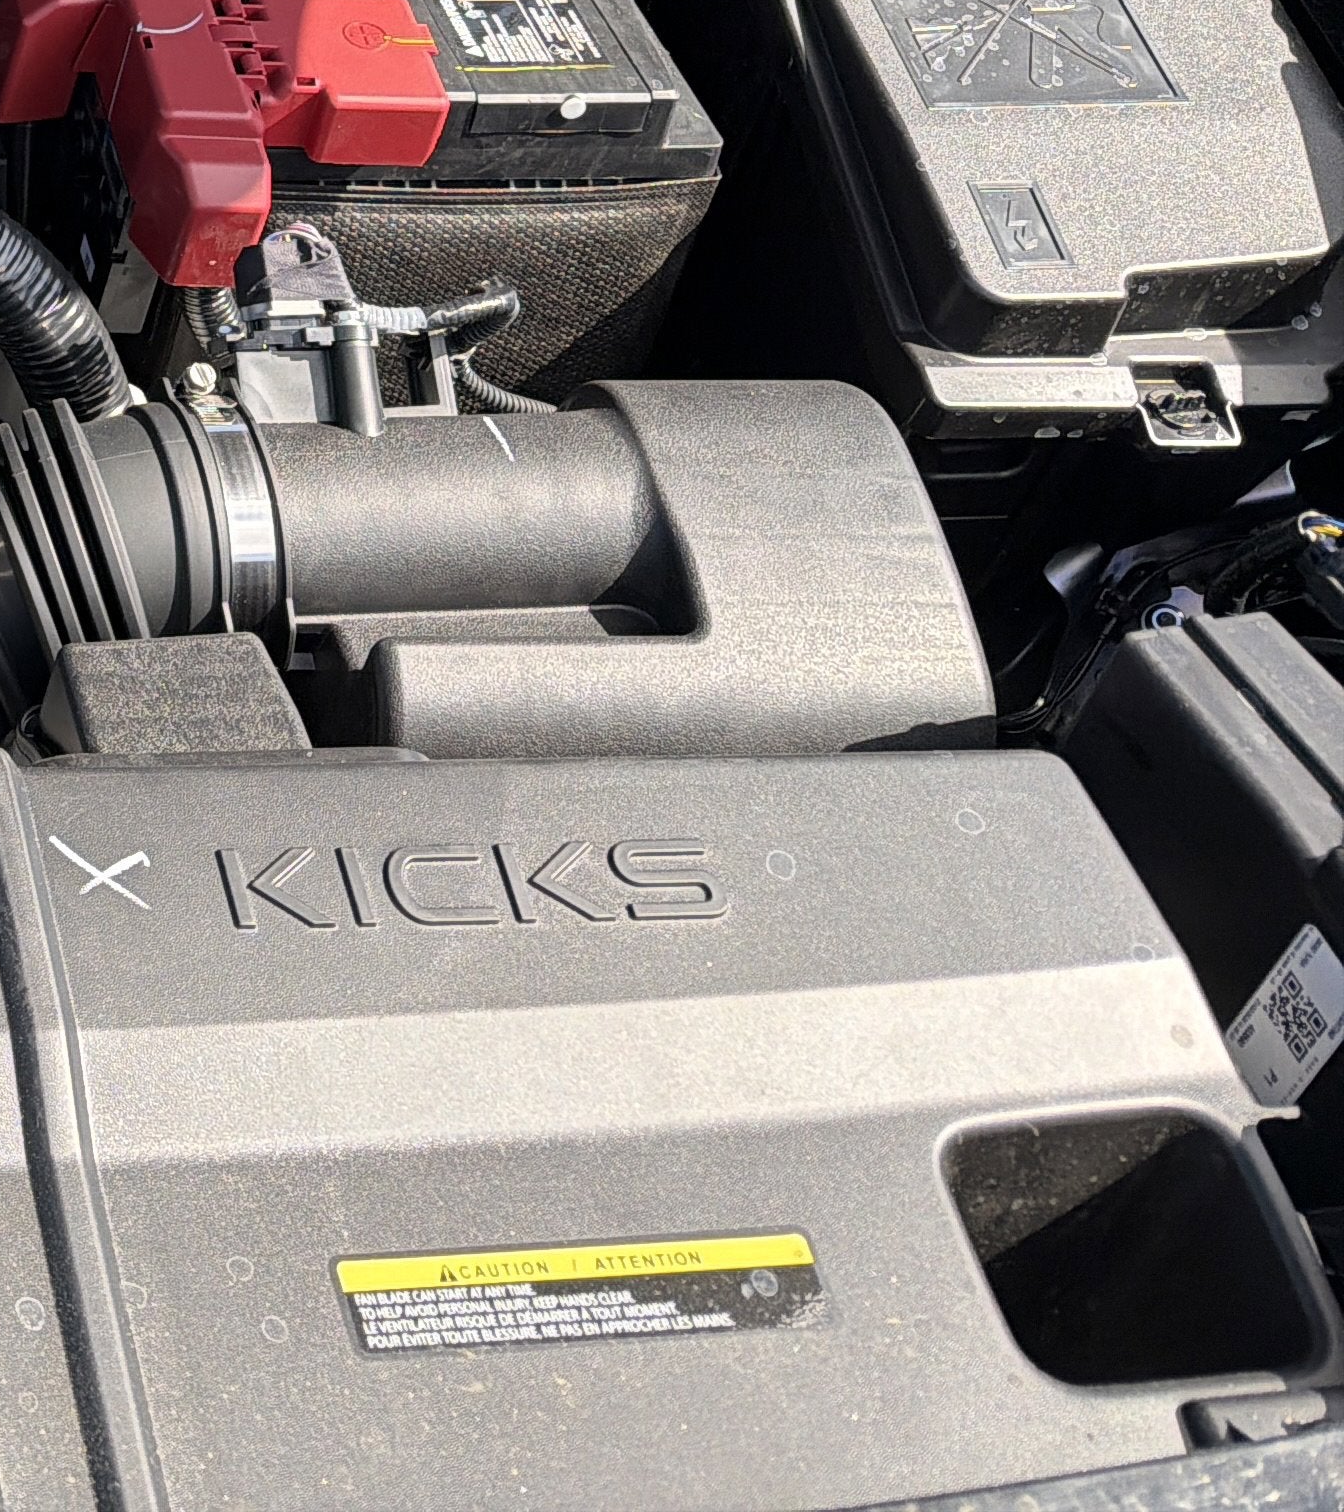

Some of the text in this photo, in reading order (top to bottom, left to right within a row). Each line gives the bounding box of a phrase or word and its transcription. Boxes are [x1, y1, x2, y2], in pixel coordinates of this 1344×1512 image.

[214, 837, 730, 931] KICKS
[459, 1261, 550, 1279] CAUTION
[595, 1251, 702, 1270] ATTENTION
[354, 1292, 376, 1306] FAN
[377, 1290, 412, 1305] BLADE
[412, 1289, 437, 1303] CAN
[438, 1287, 469, 1302] START
[470, 1286, 484, 1299] AT
[484, 1285, 509, 1298] ANY
[359, 1307, 375, 1320] TO
[376, 1305, 402, 1319] HELP
[404, 1303, 438, 1317] AVOID
[439, 1300, 493, 1316] PERSONAL
[533, 1295, 560, 1309] KEEP
[559, 1292, 597, 1307] HANDS
[363, 1320, 379, 1334] LE
[380, 1316, 454, 1334] VENTILATEUR
[456, 1313, 498, 1329] RISQUE
[499, 1312, 516, 1326] DE
[592, 1304, 623, 1319] TOUT
[367, 1334, 402, 1349] POUR
[403, 1330, 442, 1347] ÉVITER
[442, 1328, 483, 1344] TOUTE
[542, 1324, 560, 1339] NE
[561, 1321, 583, 1336] PAS
[584, 1320, 602, 1335] EN
[602, 1317, 671, 1334] APPROCHER
[672, 1314, 693, 1330] LES
